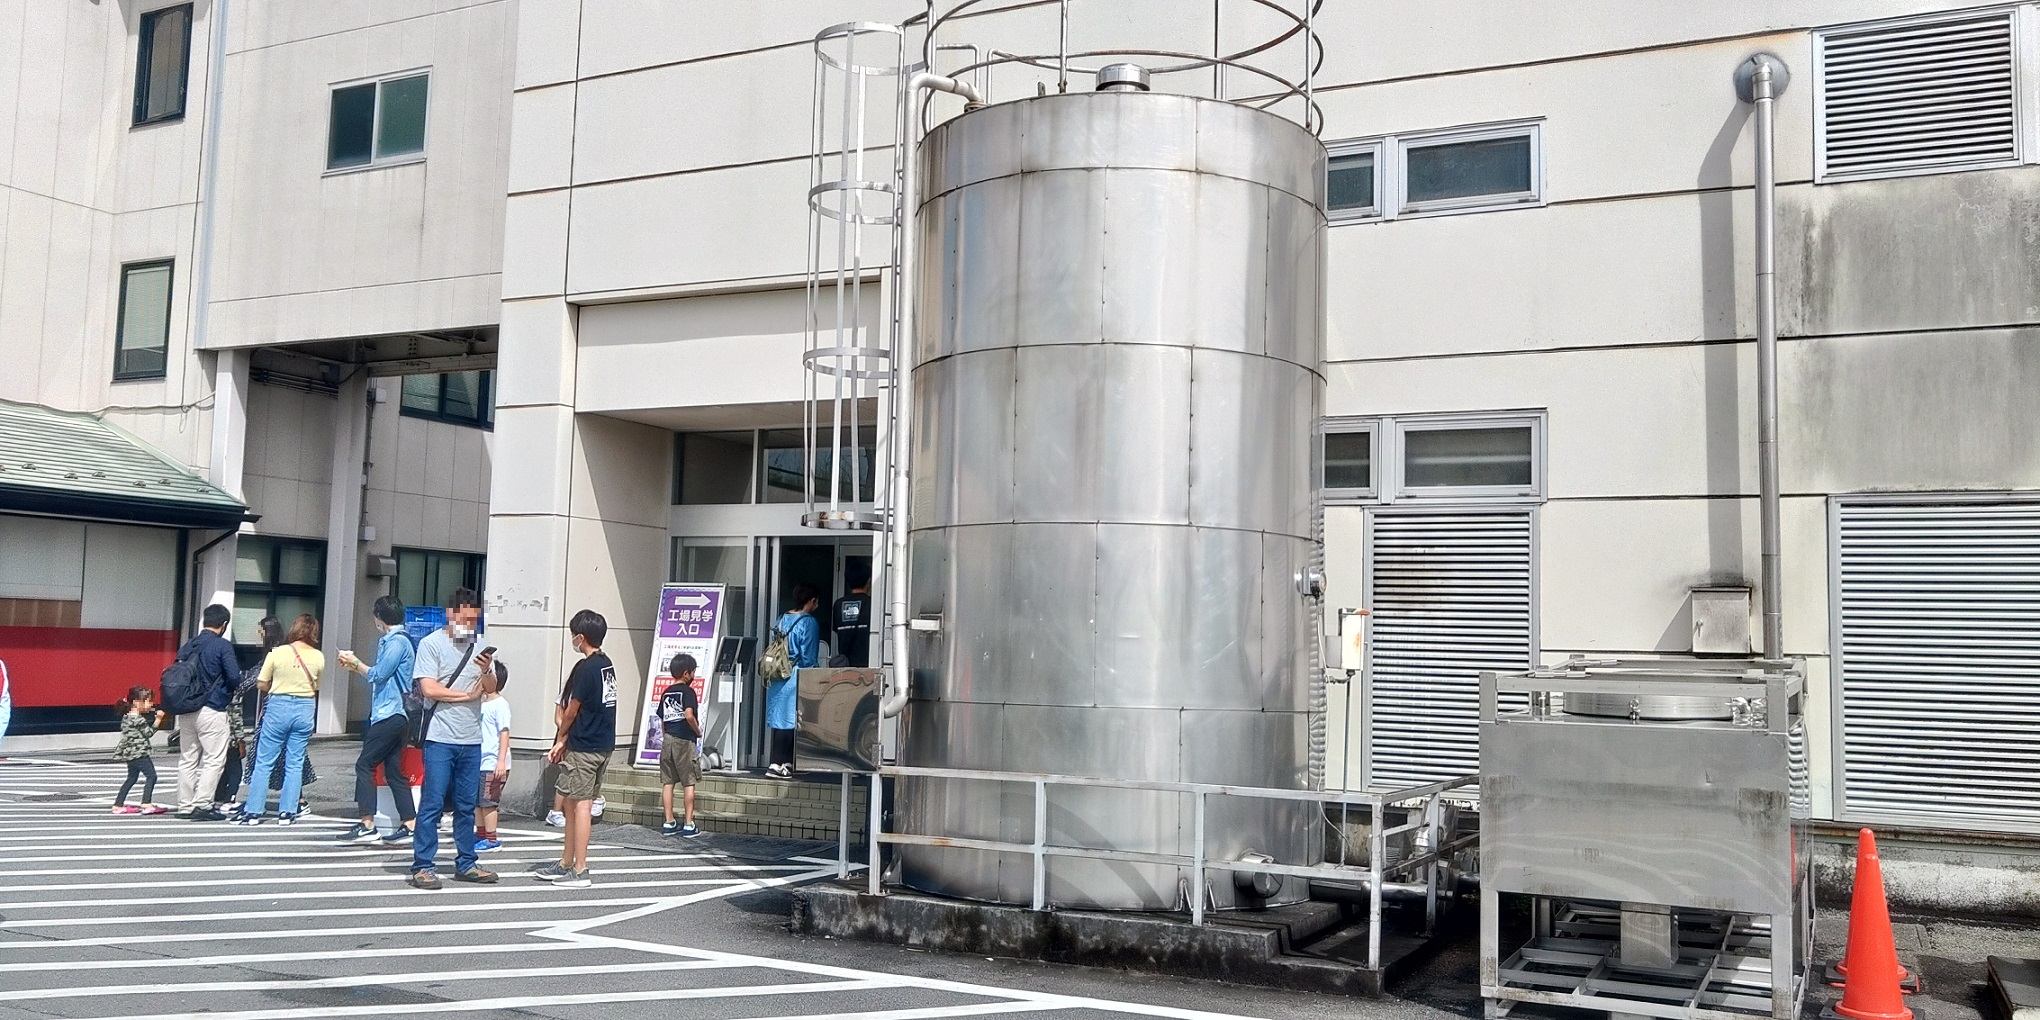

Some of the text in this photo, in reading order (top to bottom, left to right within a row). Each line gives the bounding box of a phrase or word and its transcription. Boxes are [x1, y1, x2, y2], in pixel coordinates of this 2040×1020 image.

[667, 609, 714, 622] 工場見学
[676, 623, 700, 636] 入口
